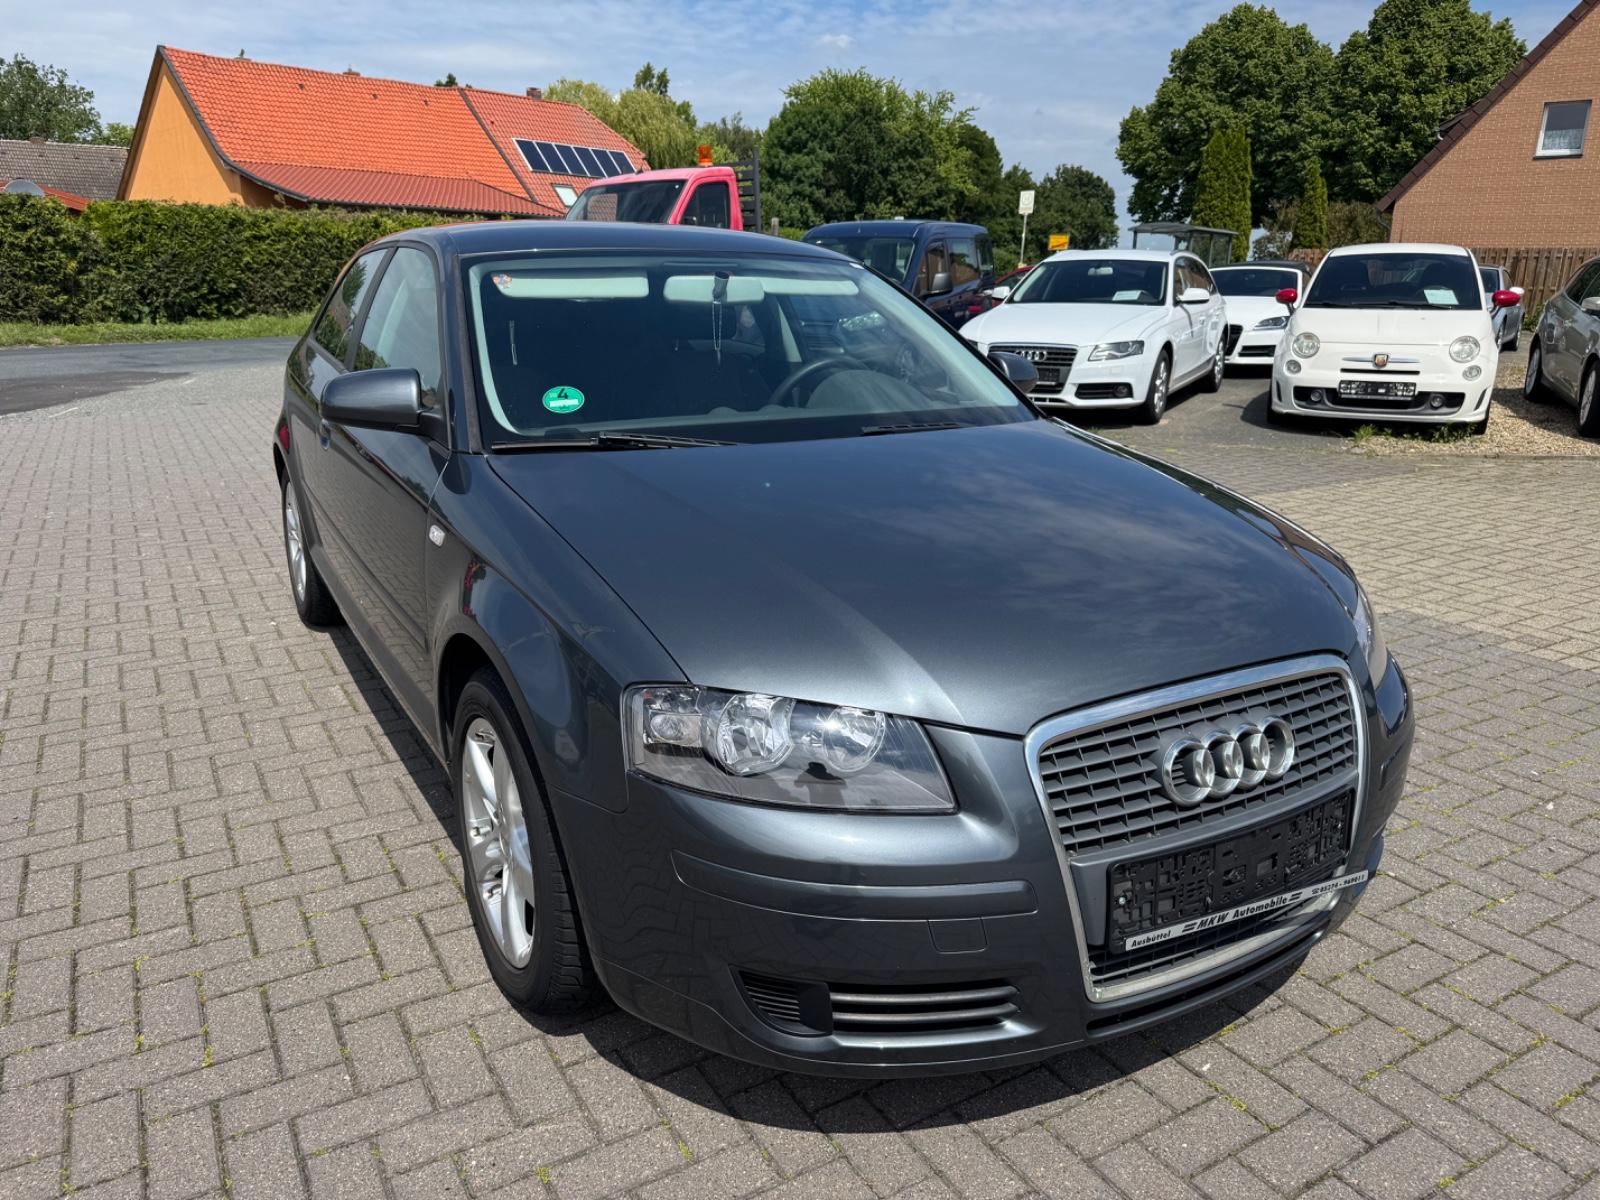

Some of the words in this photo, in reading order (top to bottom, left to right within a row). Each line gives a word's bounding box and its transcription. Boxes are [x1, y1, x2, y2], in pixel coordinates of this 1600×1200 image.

[557, 388, 569, 399] 4
[1197, 911, 1229, 930] MKW
[1232, 896, 1287, 920] Automobile
